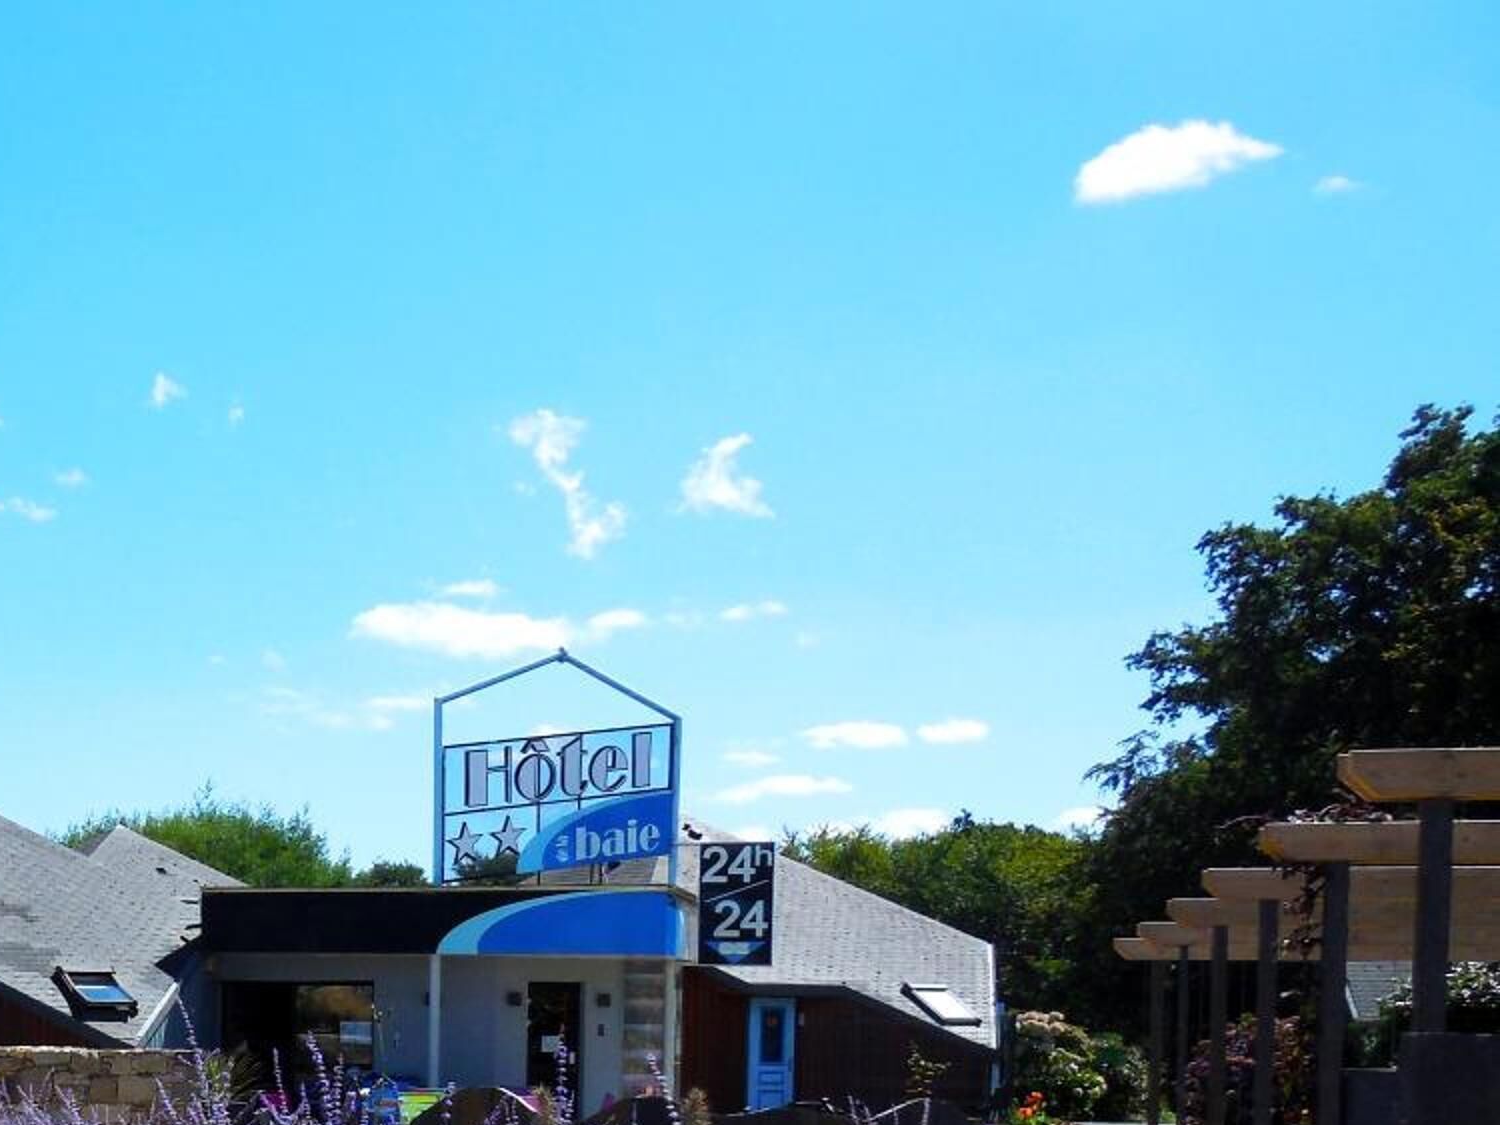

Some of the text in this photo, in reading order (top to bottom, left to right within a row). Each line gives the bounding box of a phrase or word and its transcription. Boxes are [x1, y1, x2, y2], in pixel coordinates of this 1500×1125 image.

[464, 732, 653, 809] Hôtel
[576, 819, 661, 861] baie
[701, 845, 772, 883] 24h
[713, 899, 769, 937] 24
